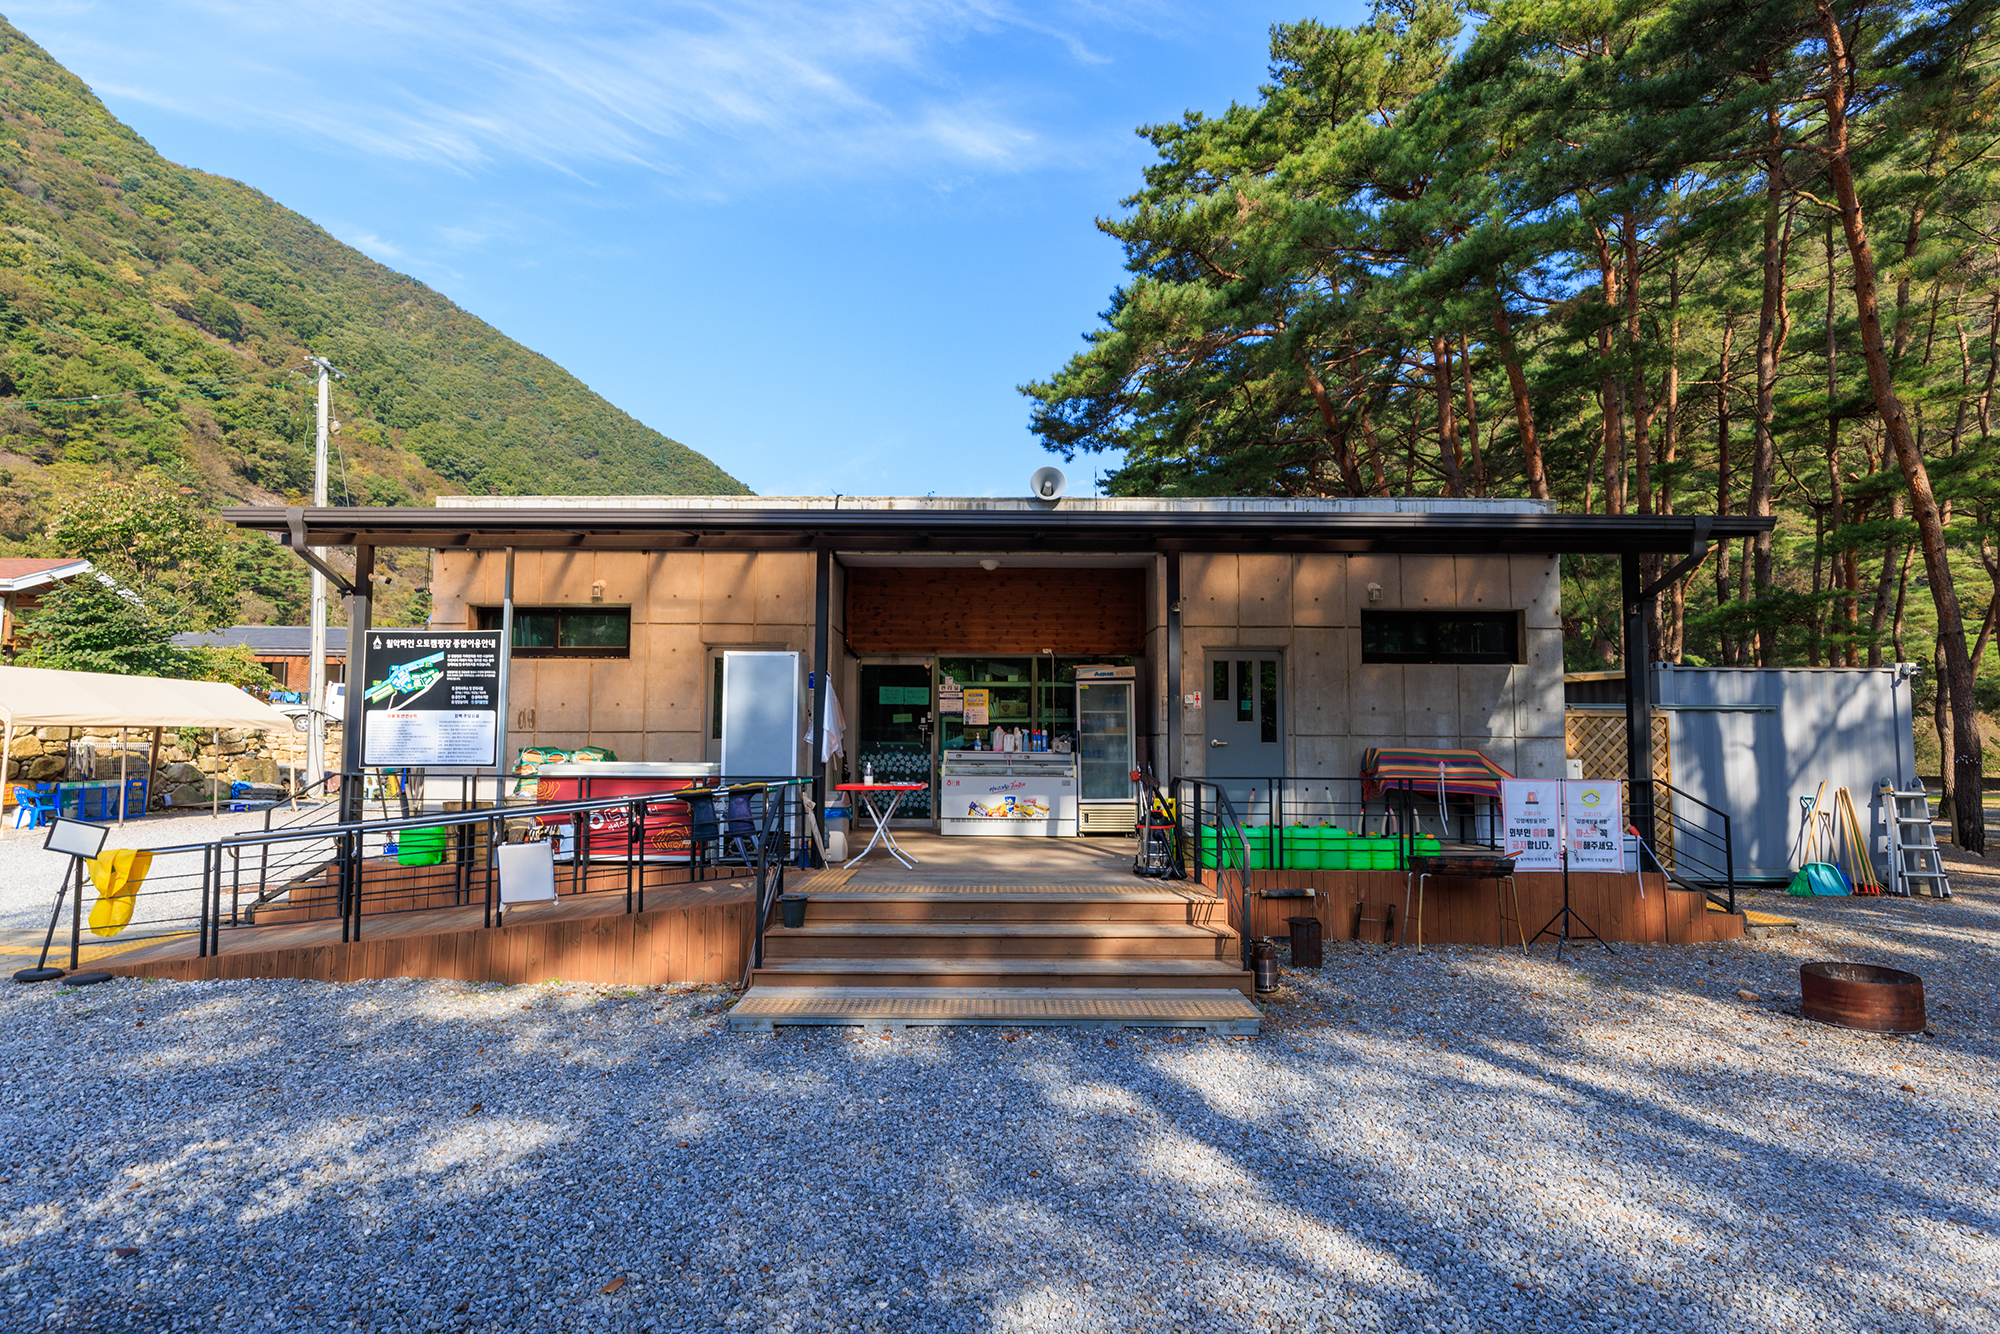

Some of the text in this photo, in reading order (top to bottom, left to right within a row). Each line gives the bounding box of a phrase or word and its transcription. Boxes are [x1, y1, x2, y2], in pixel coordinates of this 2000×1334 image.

[385, 638, 496, 649] 월악파인 오토캠핑장 종합이용안내
[1509, 828, 1555, 837] 외부인 출입을
[1512, 840, 1552, 850] 금지합니다.
